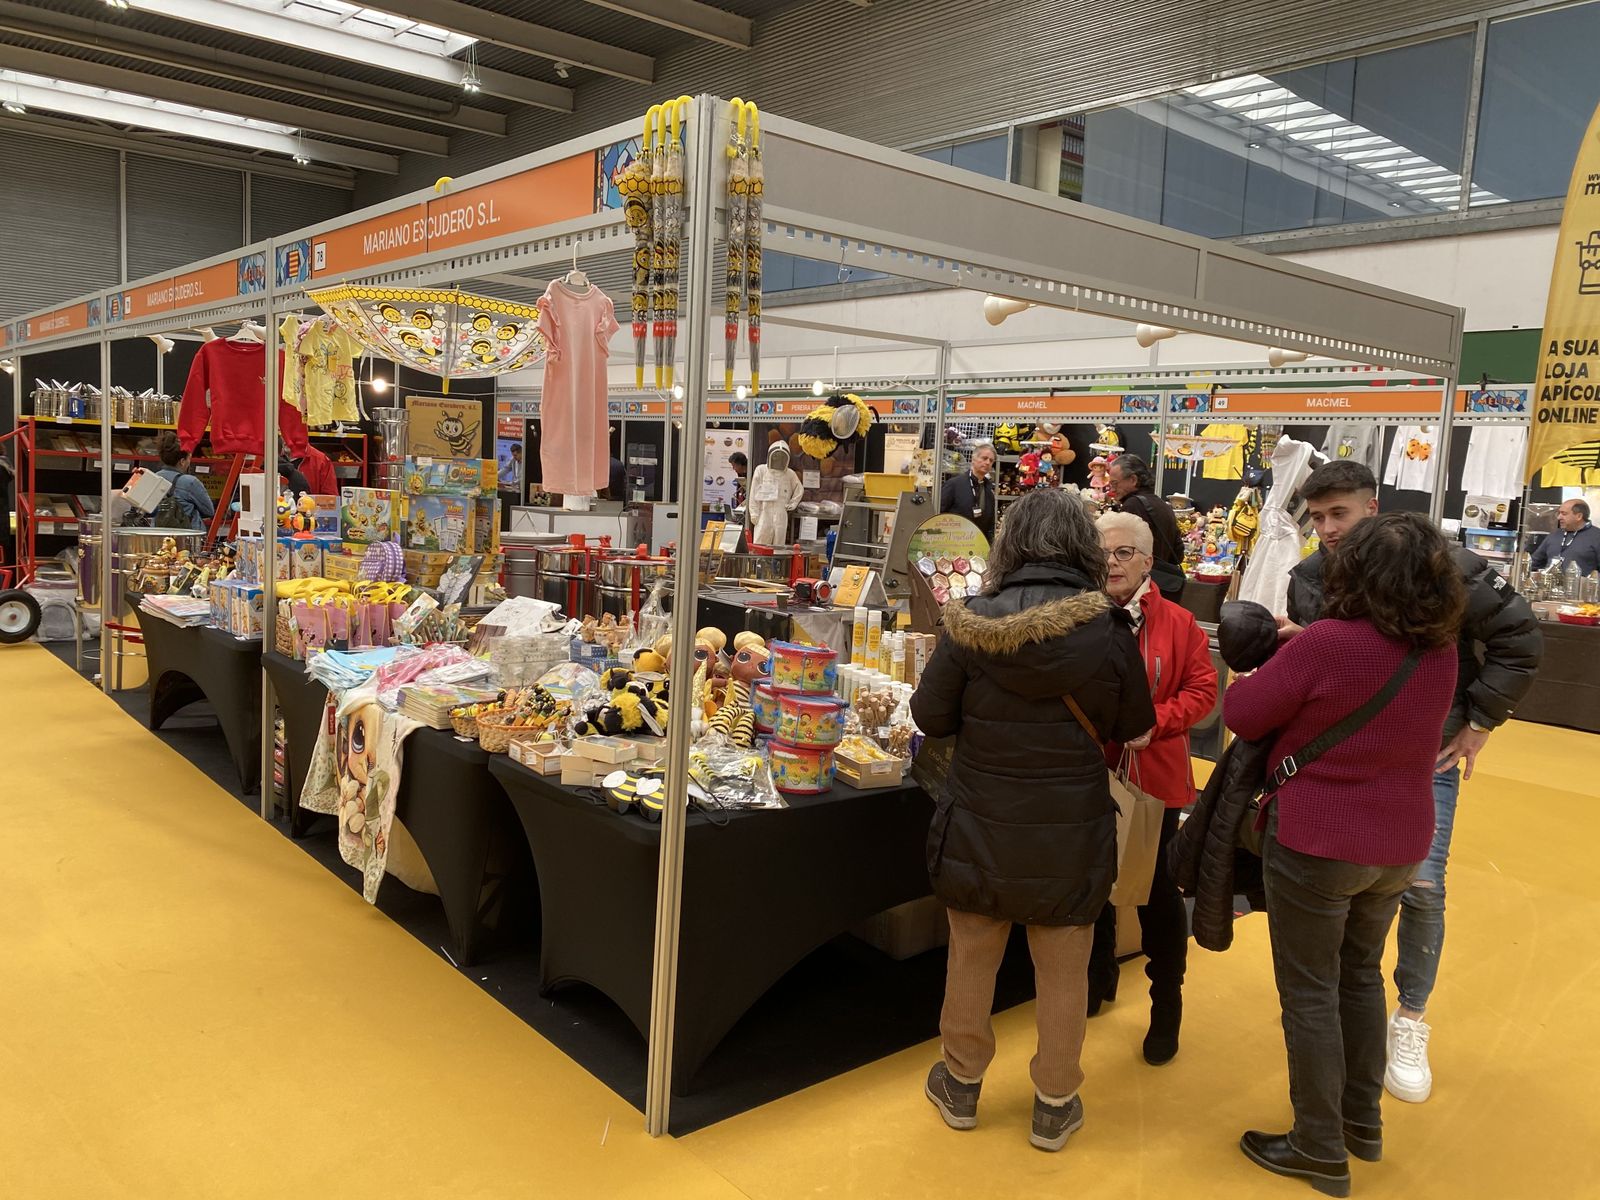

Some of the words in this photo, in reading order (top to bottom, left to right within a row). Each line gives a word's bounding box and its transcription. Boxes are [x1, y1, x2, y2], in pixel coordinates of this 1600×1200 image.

[363, 222, 410, 255] MARIANO
[413, 205, 474, 243] ESCUDERO
[477, 199, 501, 225] S.L.
[316, 250, 323, 262] 78
[1548, 340, 1558, 356] A
[1563, 339, 1599, 356] SUA
[1545, 362, 1588, 379] LOJA
[1017, 401, 1047, 409] MACMEL
[1306, 398, 1352, 408] MACMEL
[1538, 406, 1599, 423] ONLINE
